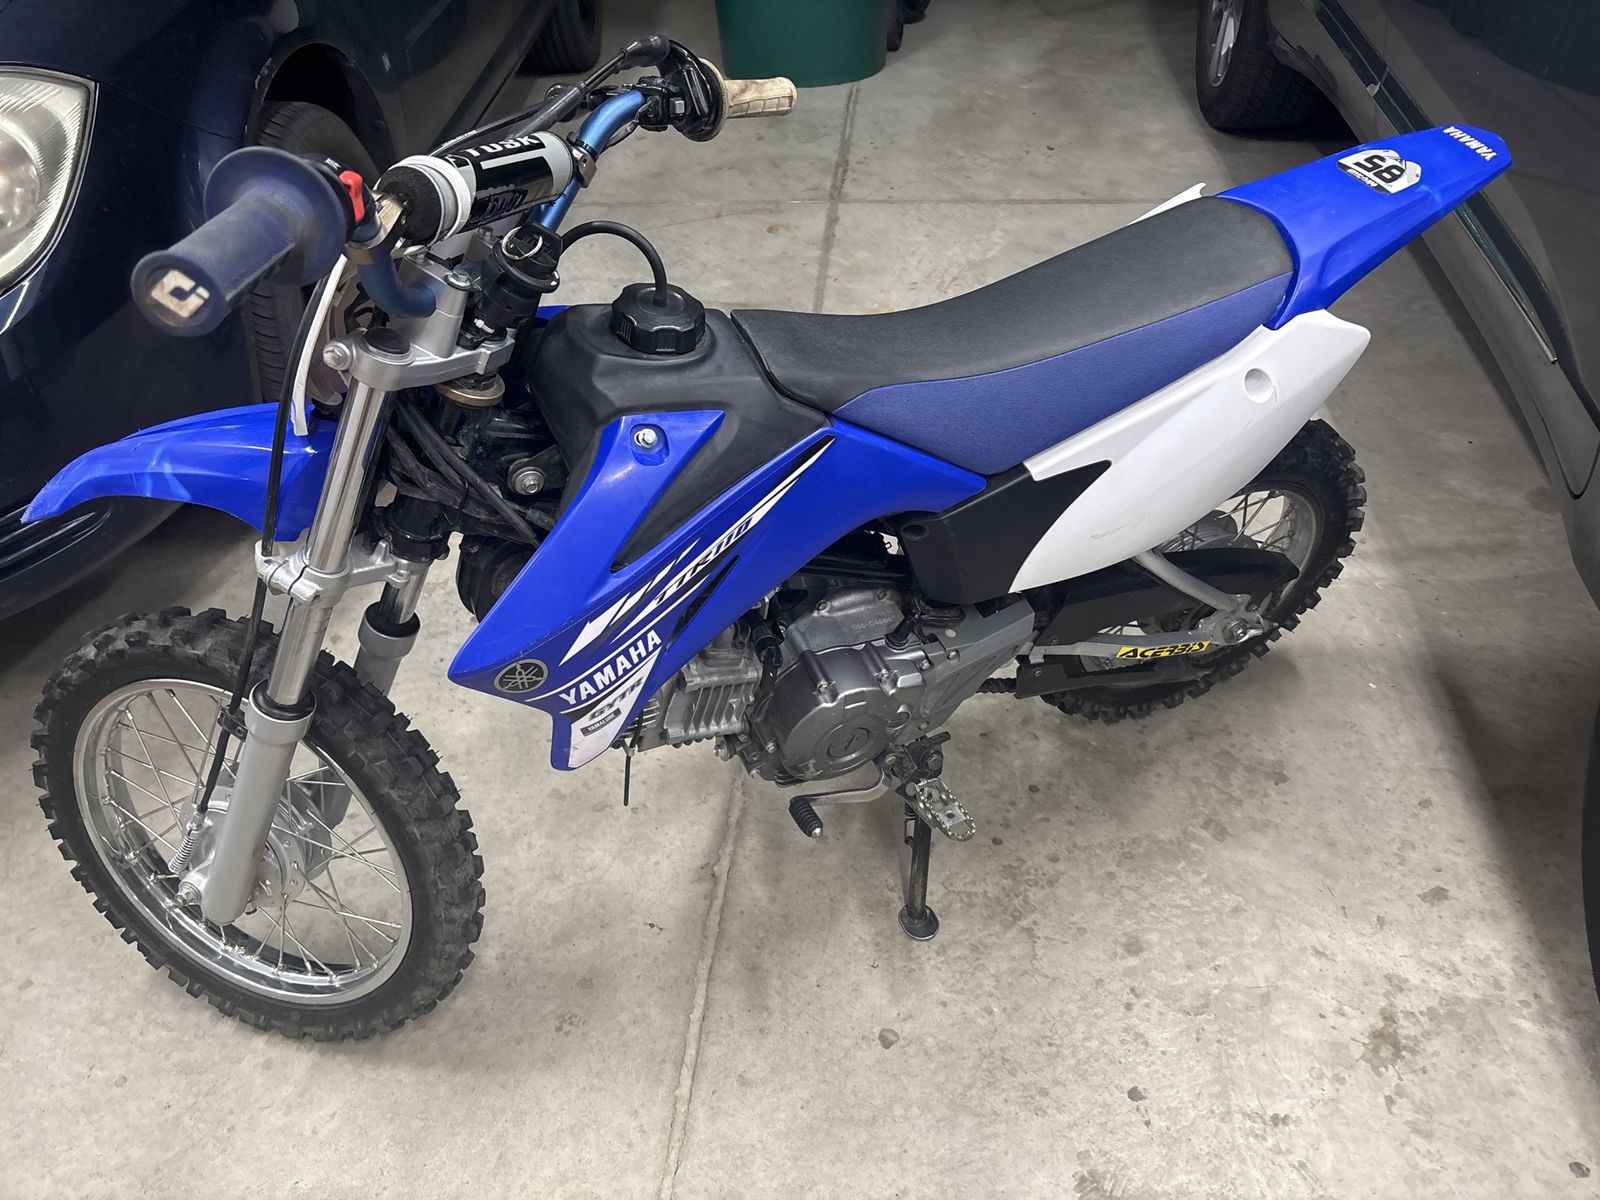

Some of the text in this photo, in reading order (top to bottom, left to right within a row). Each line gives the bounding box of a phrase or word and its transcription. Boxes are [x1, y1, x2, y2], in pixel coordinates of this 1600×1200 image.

[464, 134, 540, 157] TUSK
[1443, 126, 1497, 161] YAMAHA
[1352, 155, 1406, 183] 85
[1119, 641, 1206, 658] ACERBIS
[558, 629, 662, 705] YAMAHA
[588, 676, 645, 721] GYTR
